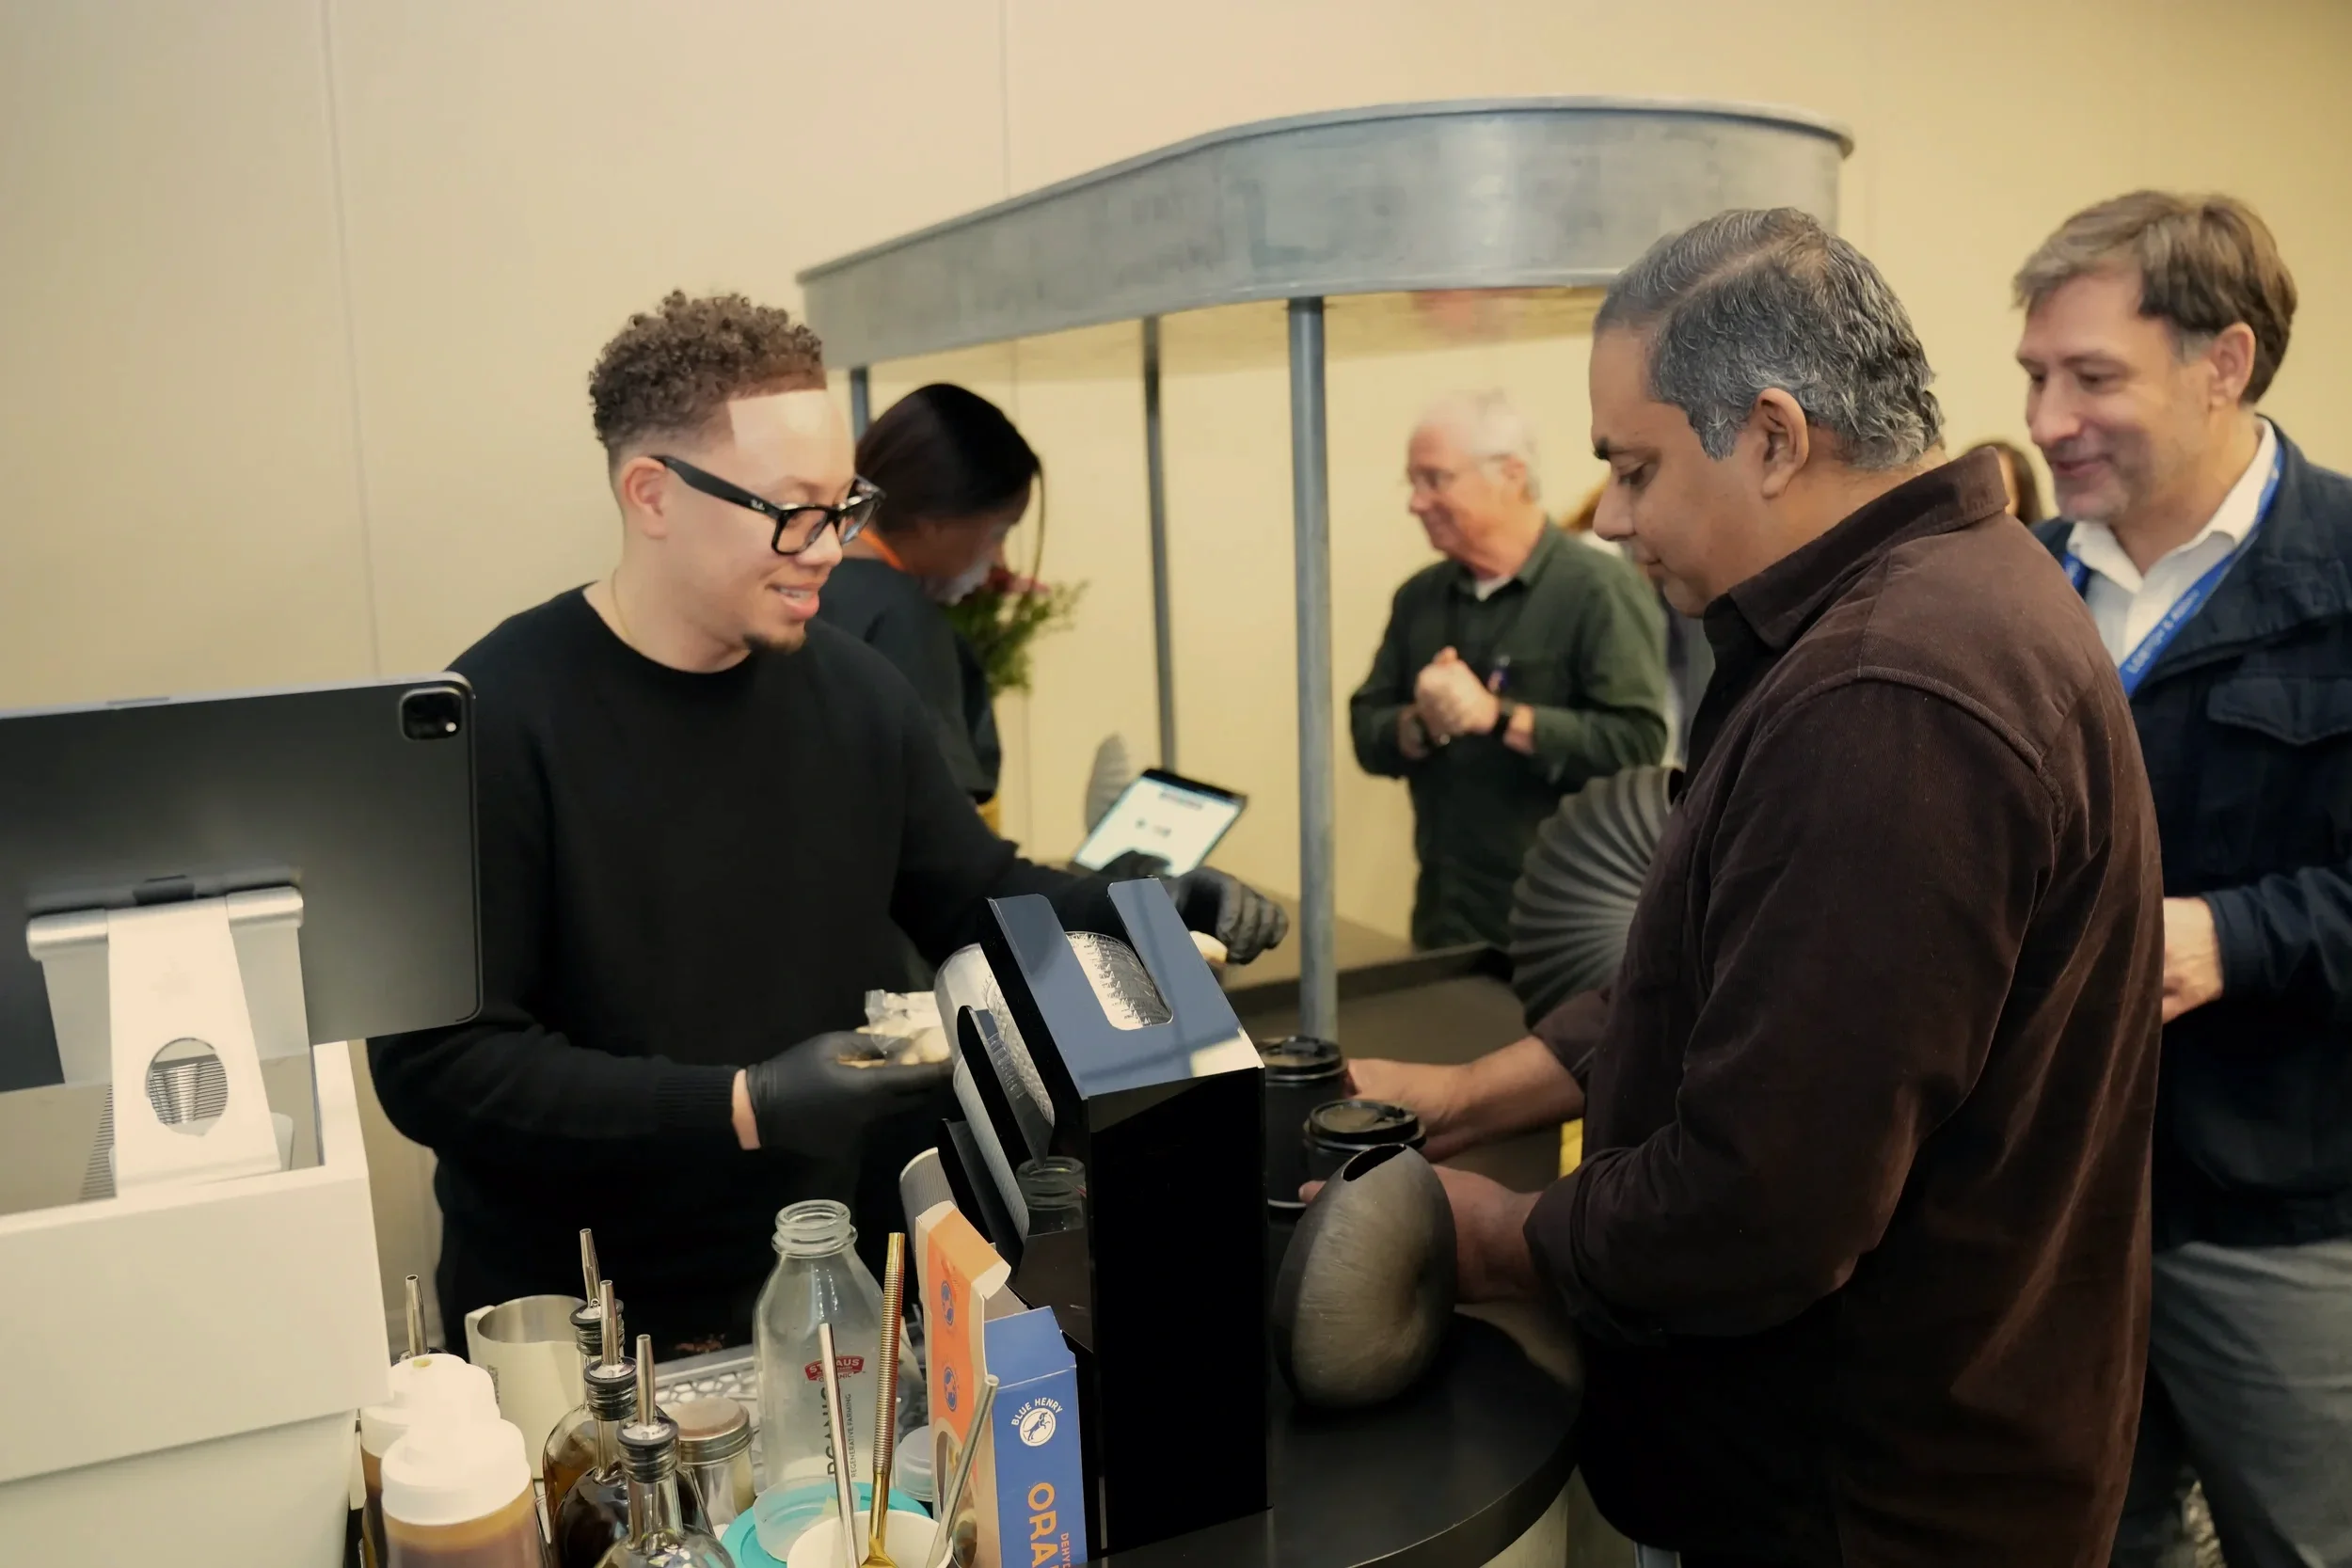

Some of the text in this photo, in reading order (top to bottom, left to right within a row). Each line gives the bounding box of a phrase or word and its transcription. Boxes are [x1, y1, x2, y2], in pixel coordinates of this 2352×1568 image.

[809, 1358, 860, 1373] STAUS
[818, 1373, 851, 1382] ONIC
[1010, 1397, 1063, 1425] BLUE HENRY
[845, 1393, 857, 1478] REGENERATIVE FARMING
[1027, 1482, 1059, 1568] ORA
